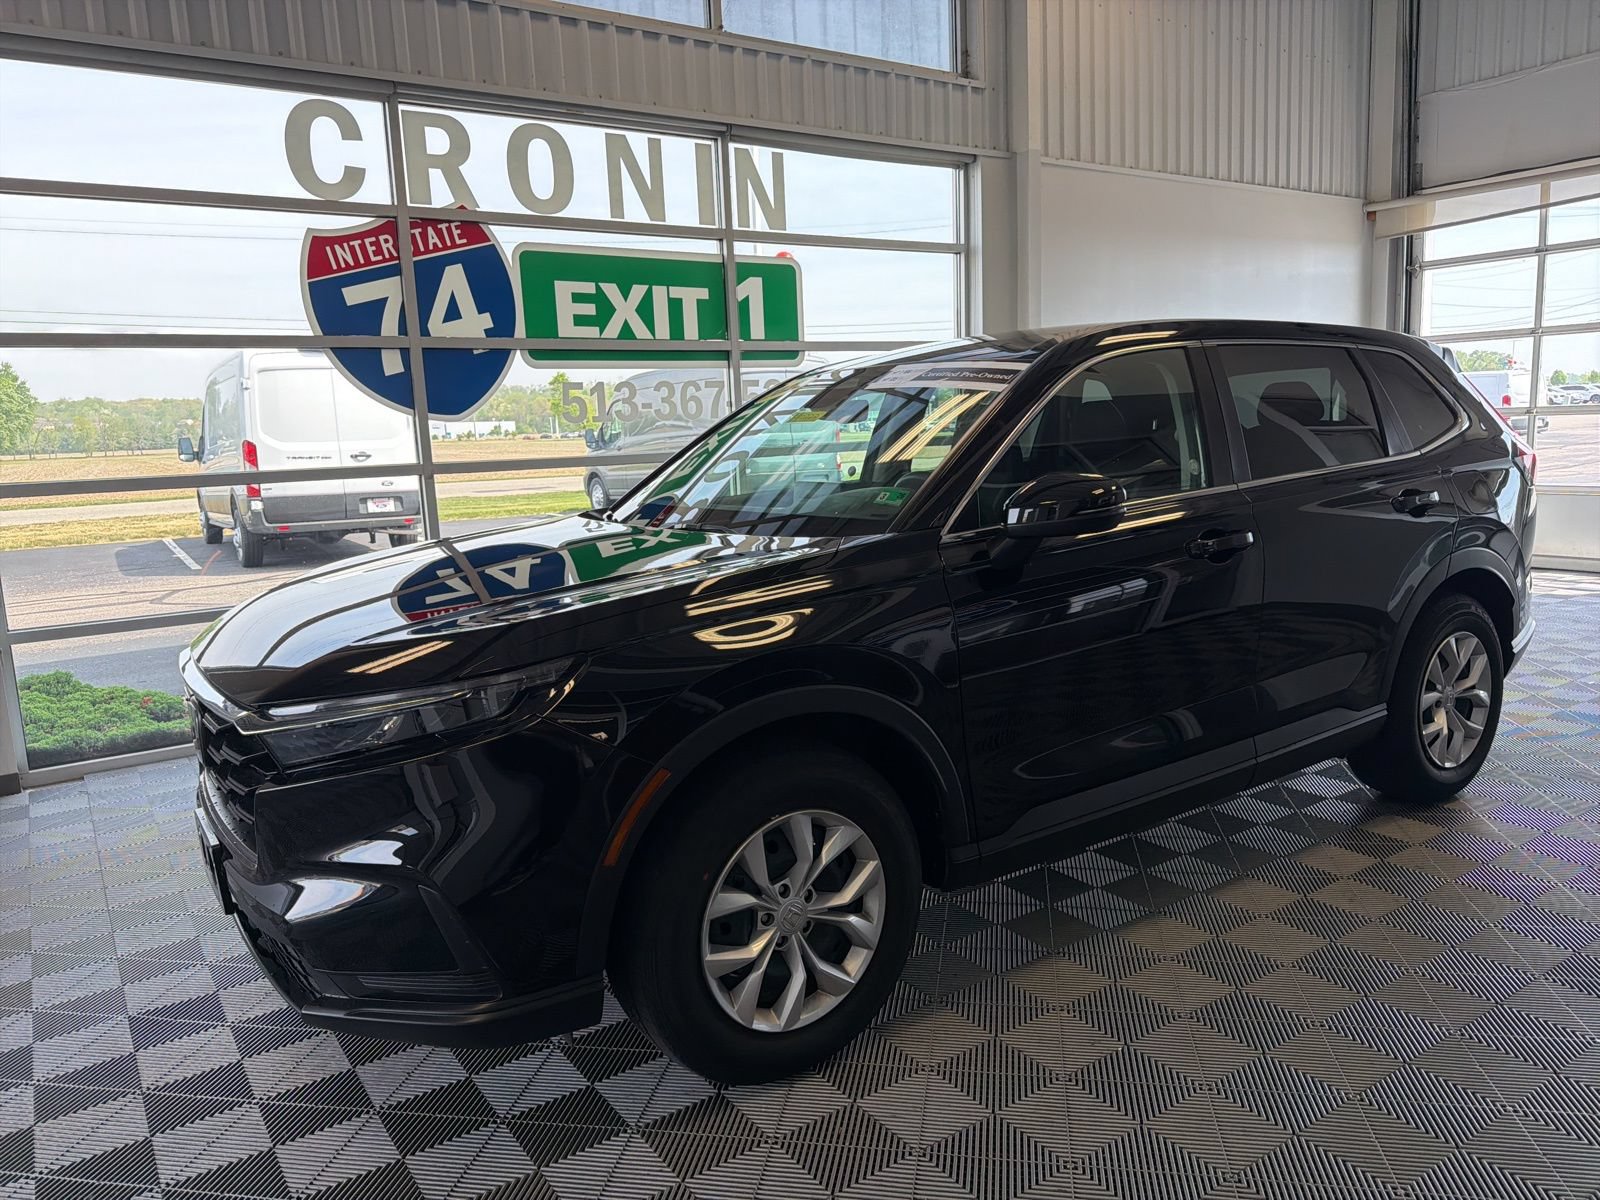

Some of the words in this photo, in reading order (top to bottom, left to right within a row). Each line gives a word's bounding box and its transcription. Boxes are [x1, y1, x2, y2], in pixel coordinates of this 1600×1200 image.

[284, 98, 787, 231] CRONIN
[325, 221, 468, 271] INTERTATE
[341, 262, 495, 377] 74
[553, 280, 710, 340] EXIT
[735, 276, 766, 340] 1
